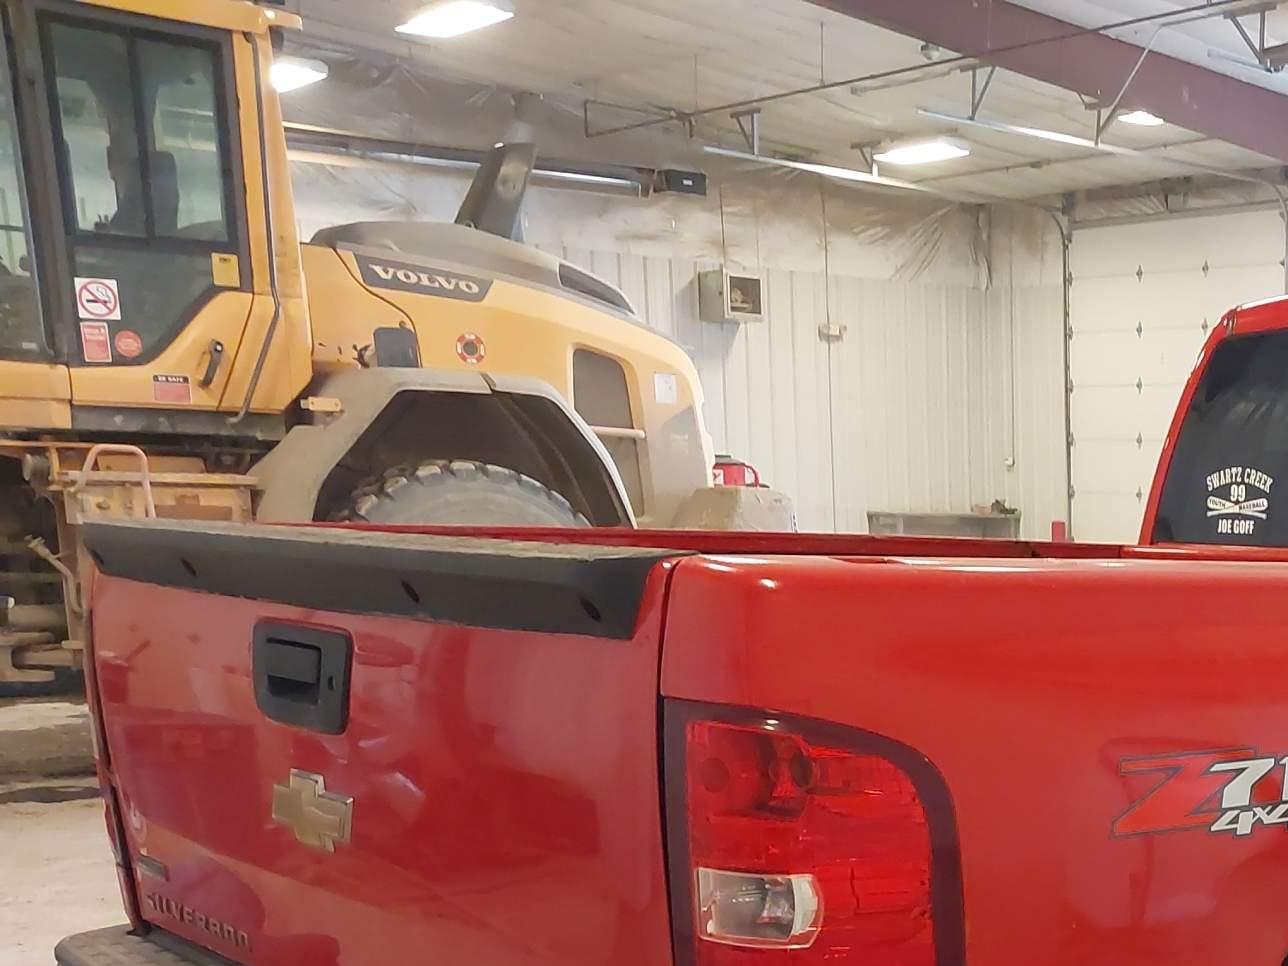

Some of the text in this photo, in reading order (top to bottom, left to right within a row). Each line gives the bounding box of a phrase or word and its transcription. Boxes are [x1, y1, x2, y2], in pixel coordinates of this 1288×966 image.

[368, 263, 479, 294] VOLVO
[1206, 466, 1274, 494] SWARTZ CREEK
[1230, 484, 1246, 502] 99
[1217, 519, 1255, 535] JOE GOFF
[145, 893, 252, 951] SILVERADO
